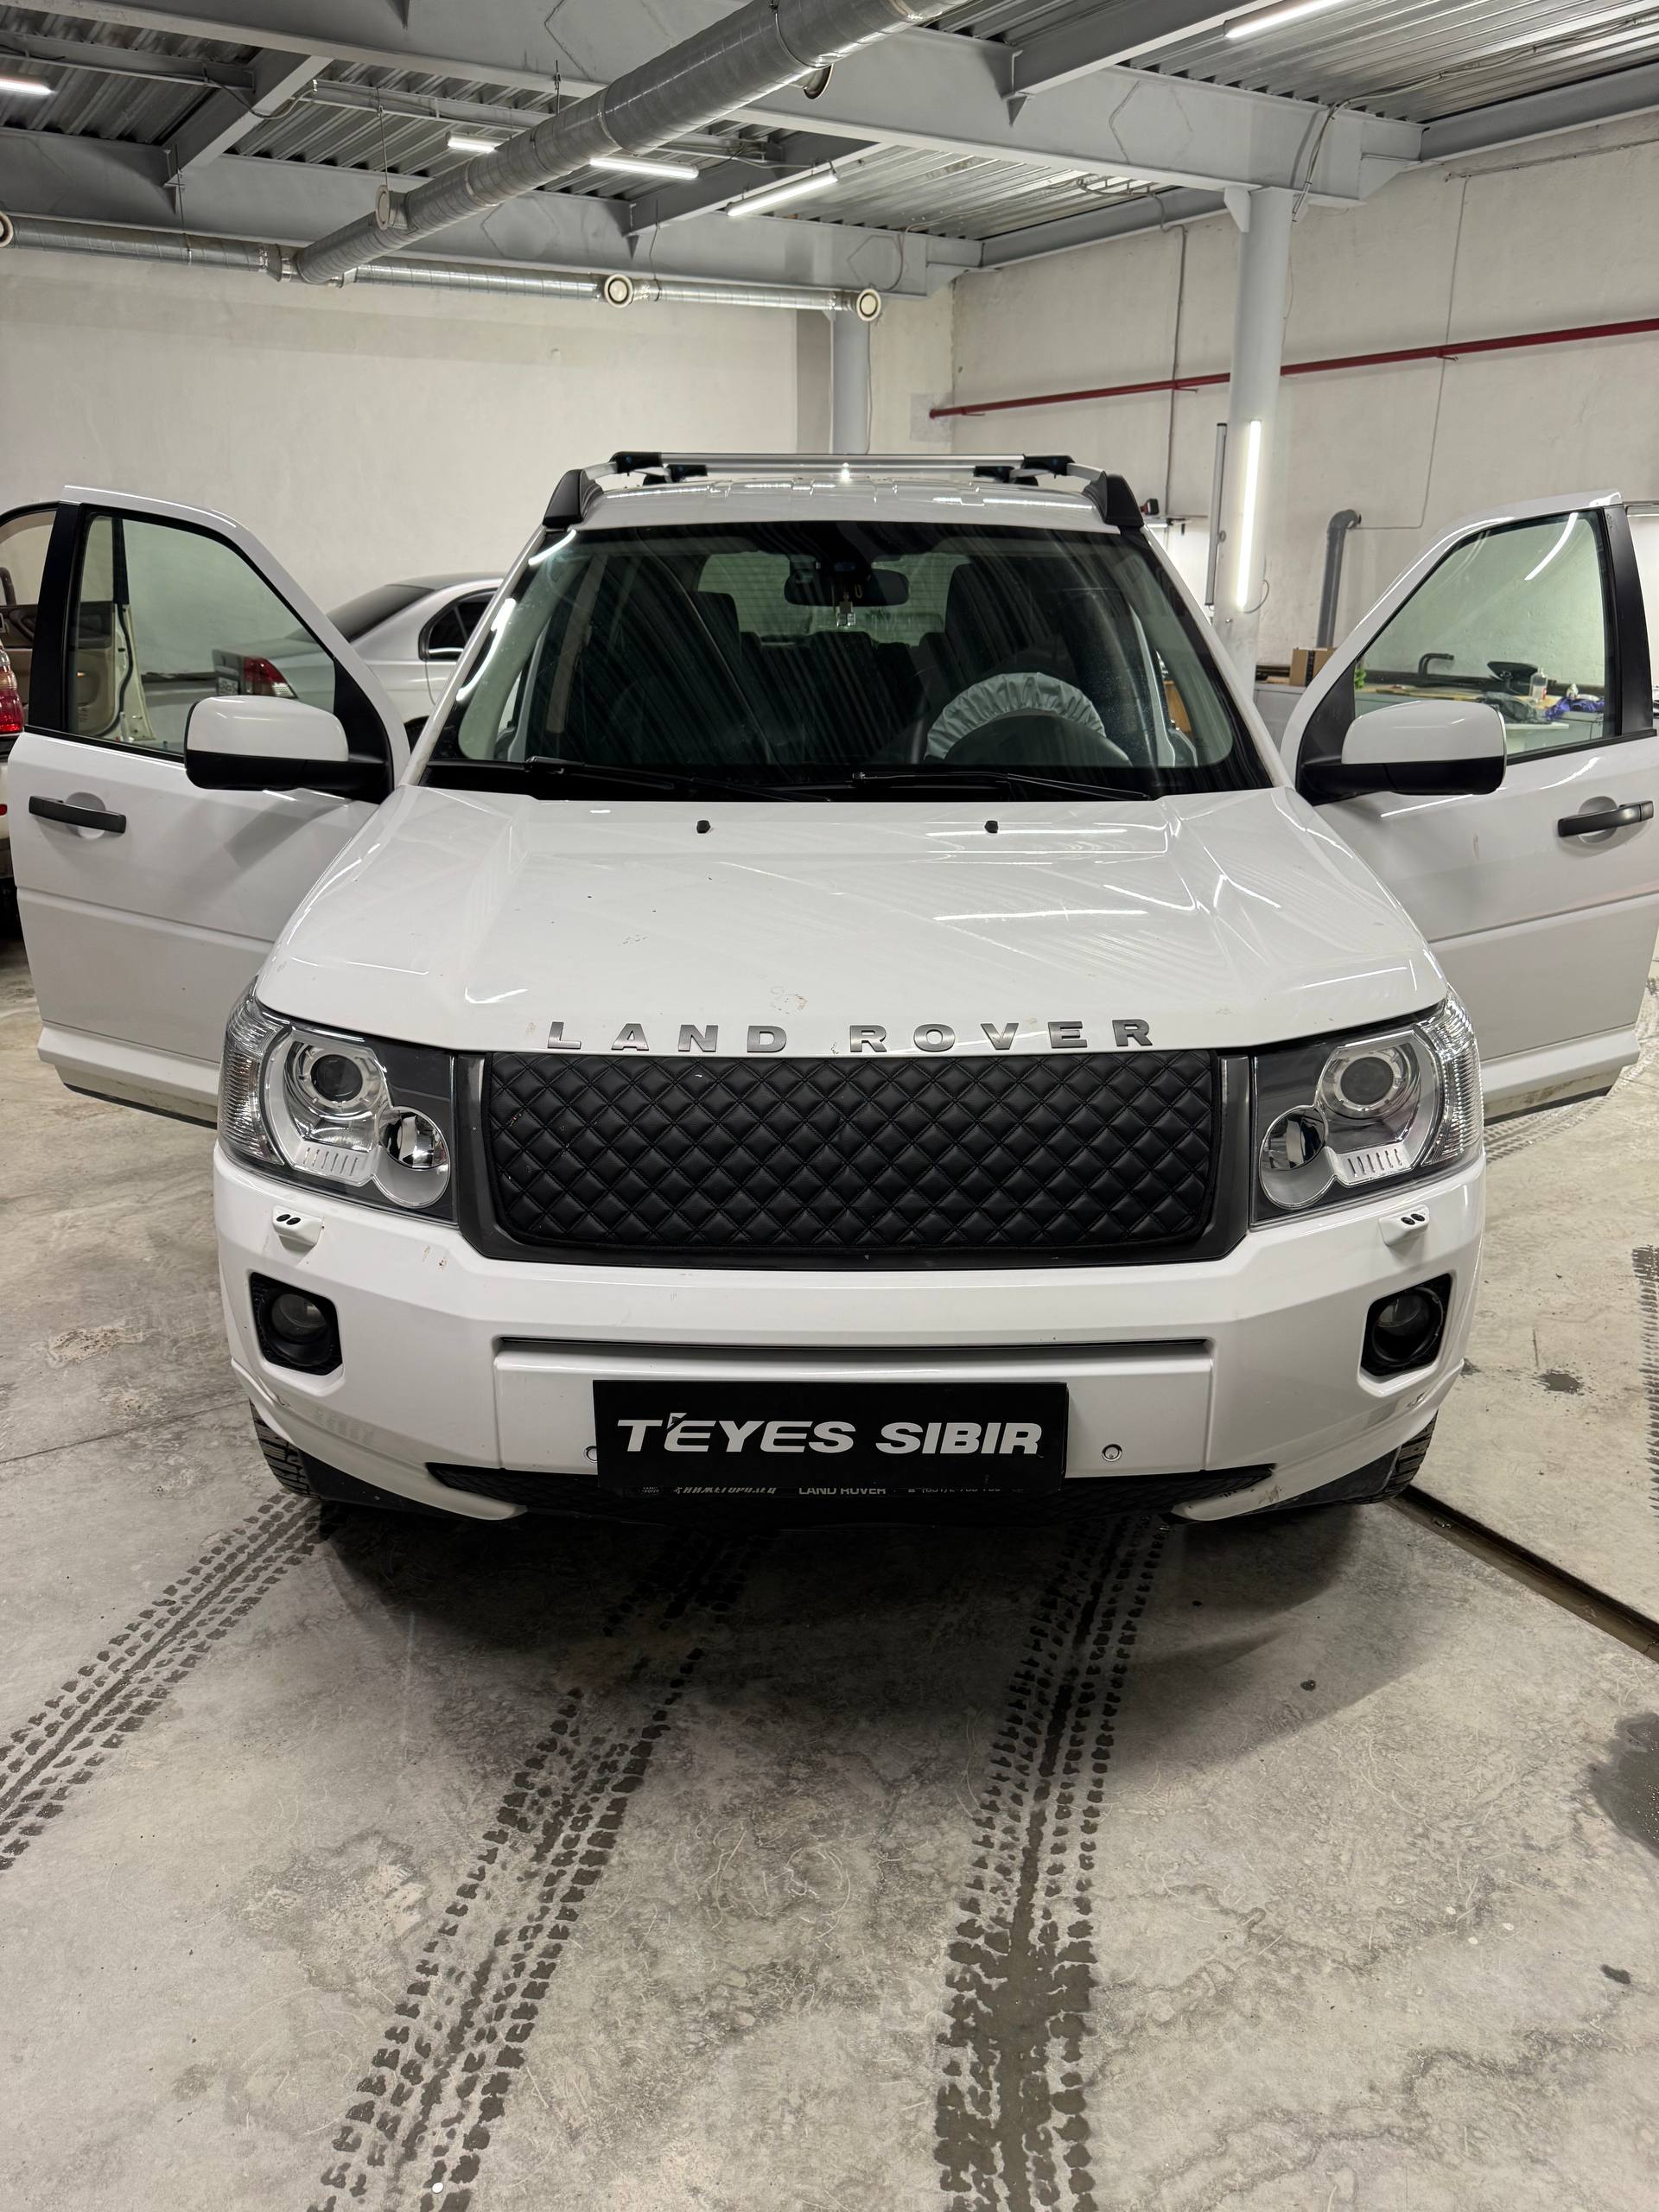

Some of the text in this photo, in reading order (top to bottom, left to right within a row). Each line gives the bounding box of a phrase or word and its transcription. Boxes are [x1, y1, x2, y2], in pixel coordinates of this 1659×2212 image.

[546, 1019, 1154, 1053] LAND ROVER
[617, 1413, 1043, 1454] TEYES SIBIR
[798, 1486, 837, 1496] LAND
